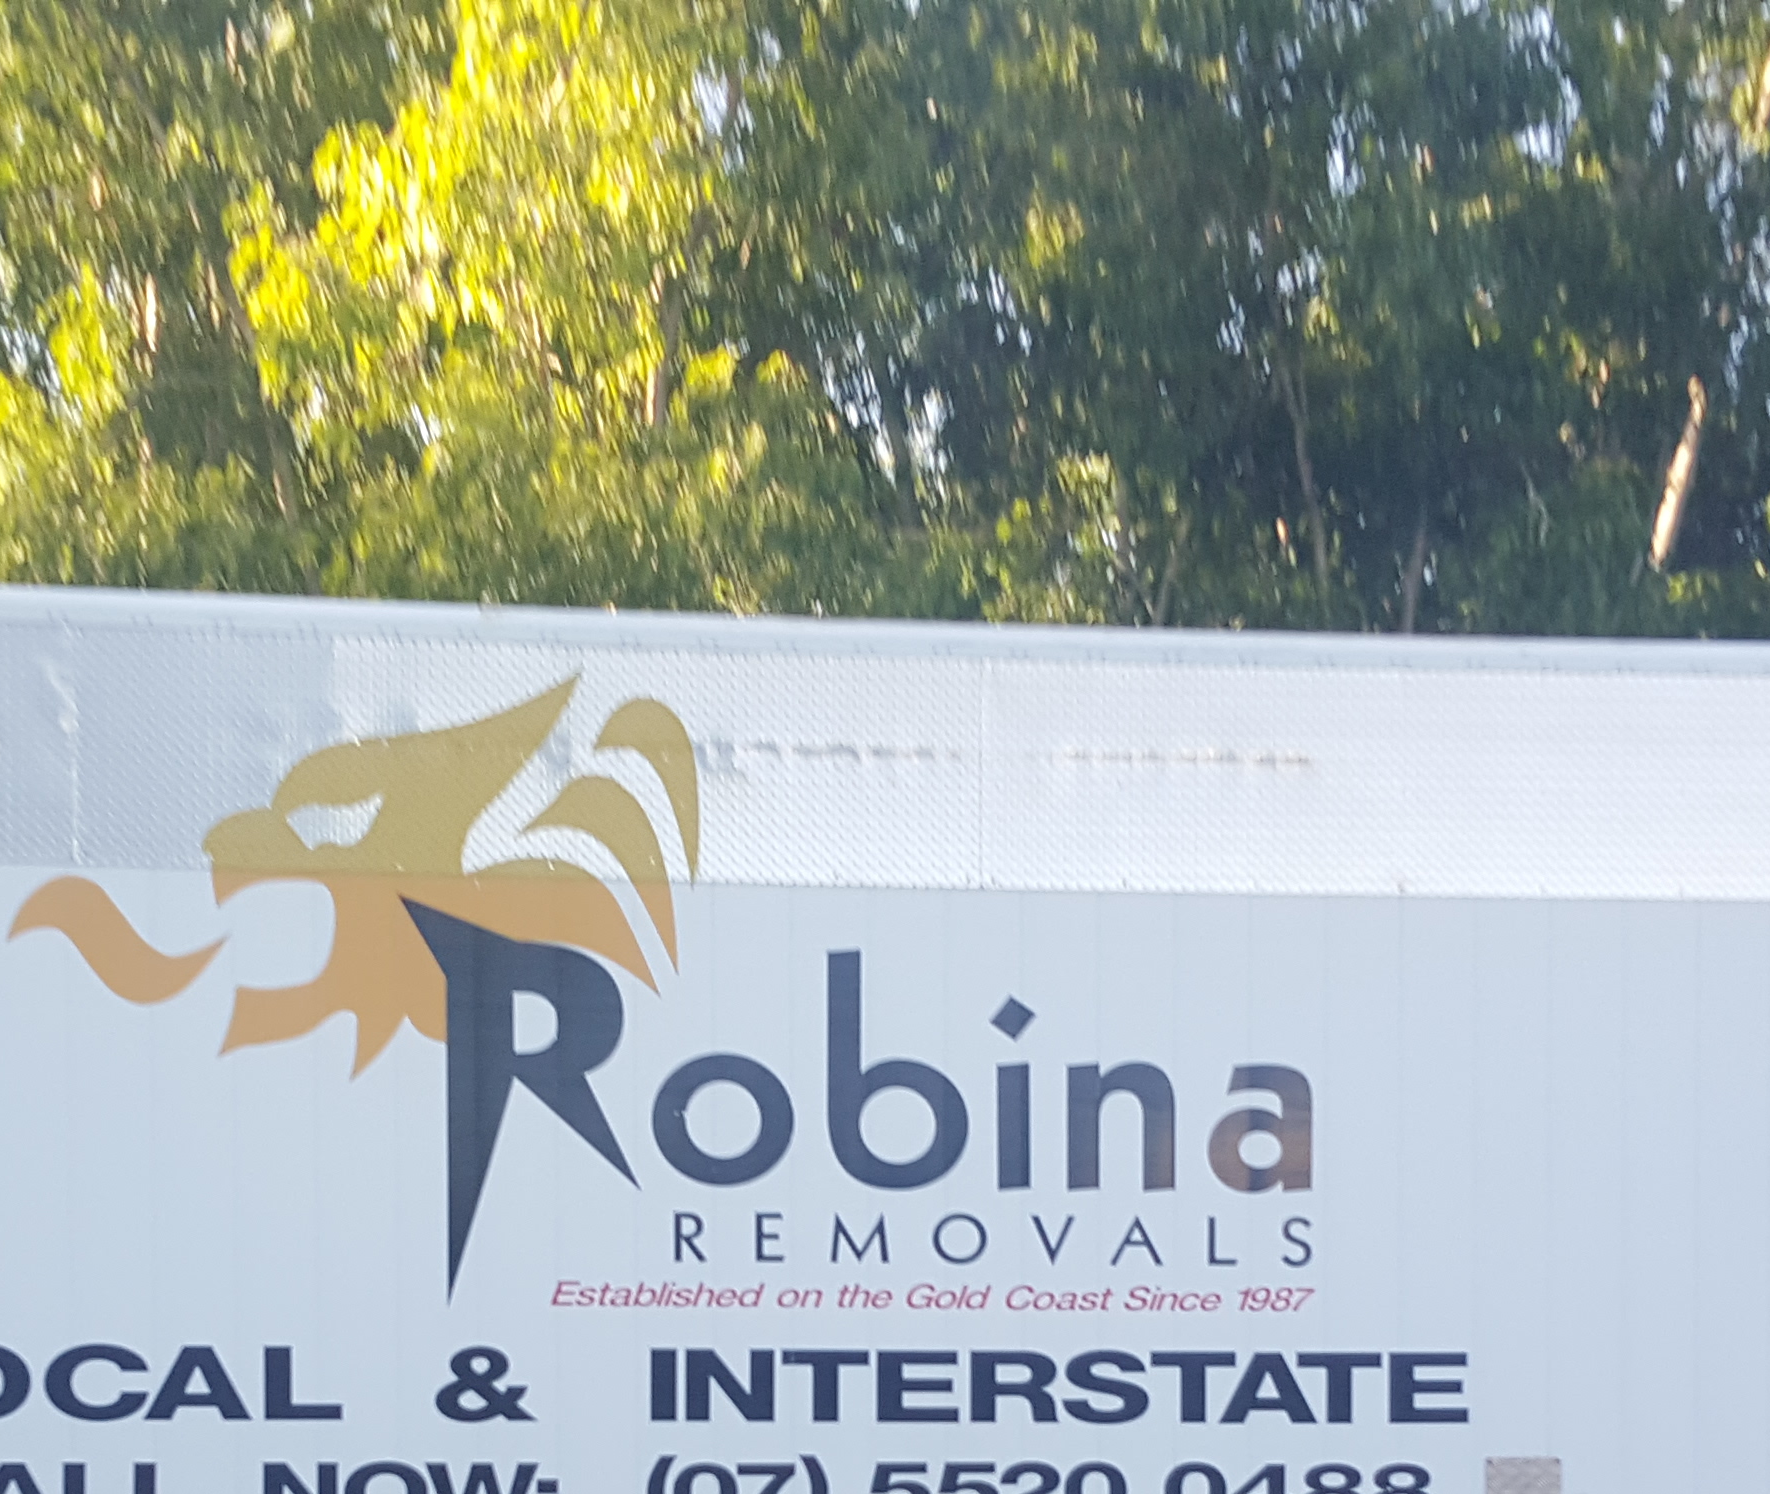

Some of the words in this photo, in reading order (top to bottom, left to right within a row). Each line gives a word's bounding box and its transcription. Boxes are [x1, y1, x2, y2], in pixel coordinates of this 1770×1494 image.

[398, 894, 1314, 1308] Robina
[671, 1211, 1314, 1267] REMOVALS
[551, 1280, 765, 1308] Established
[776, 1286, 823, 1308] on
[837, 1284, 892, 1309] the
[906, 1283, 991, 1310] Gold
[1005, 1285, 1113, 1312] Coast
[1124, 1286, 1222, 1312] Since
[1237, 1287, 1314, 1312] 1987
[434, 1346, 538, 1424] &
[649, 1348, 1471, 1425] INTERSTATE
